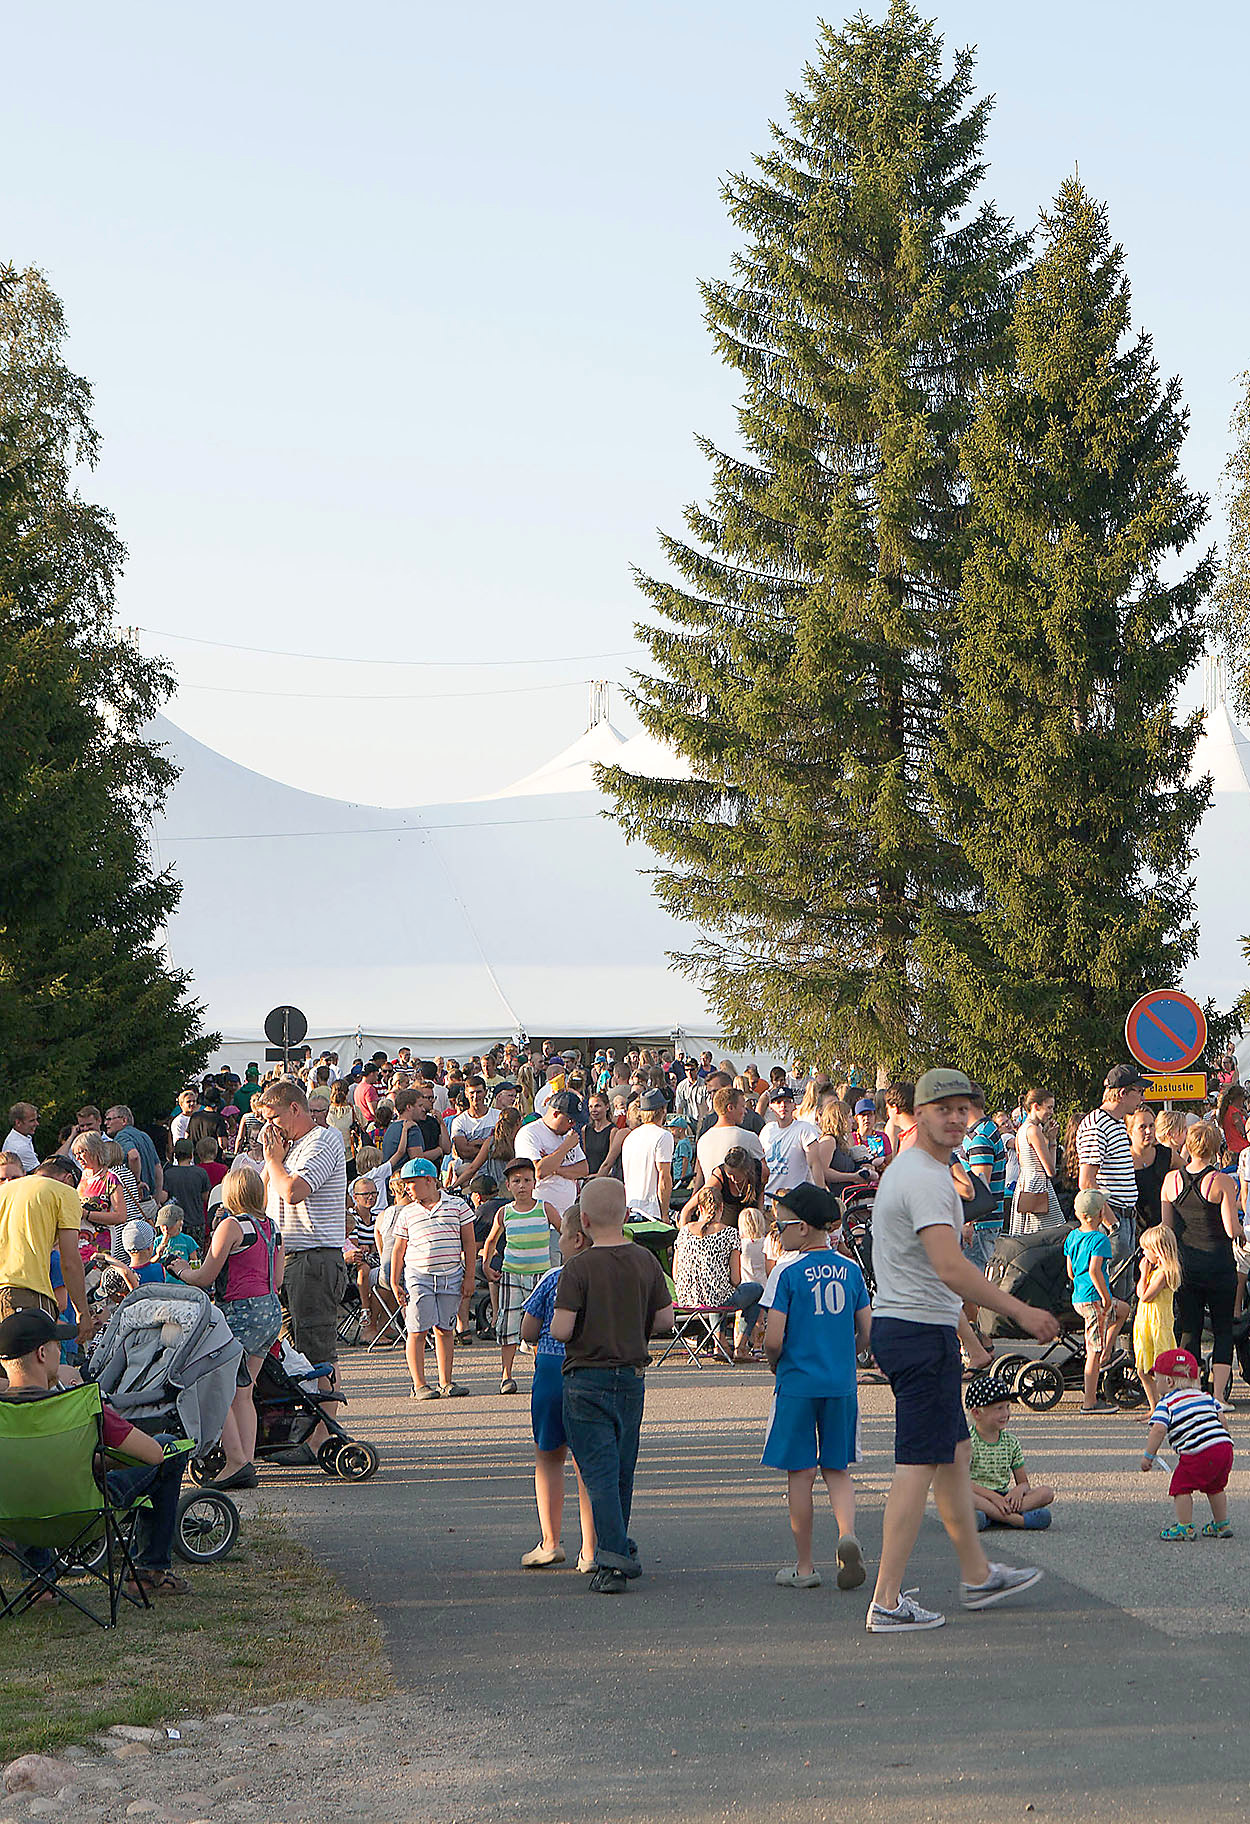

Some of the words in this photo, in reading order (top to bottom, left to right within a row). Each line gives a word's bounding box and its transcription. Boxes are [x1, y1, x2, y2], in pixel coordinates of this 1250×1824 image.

[1149, 1082, 1194, 1093] elastustie
[804, 1264, 848, 1282] SUOMI
[810, 1280, 846, 1316] 10
